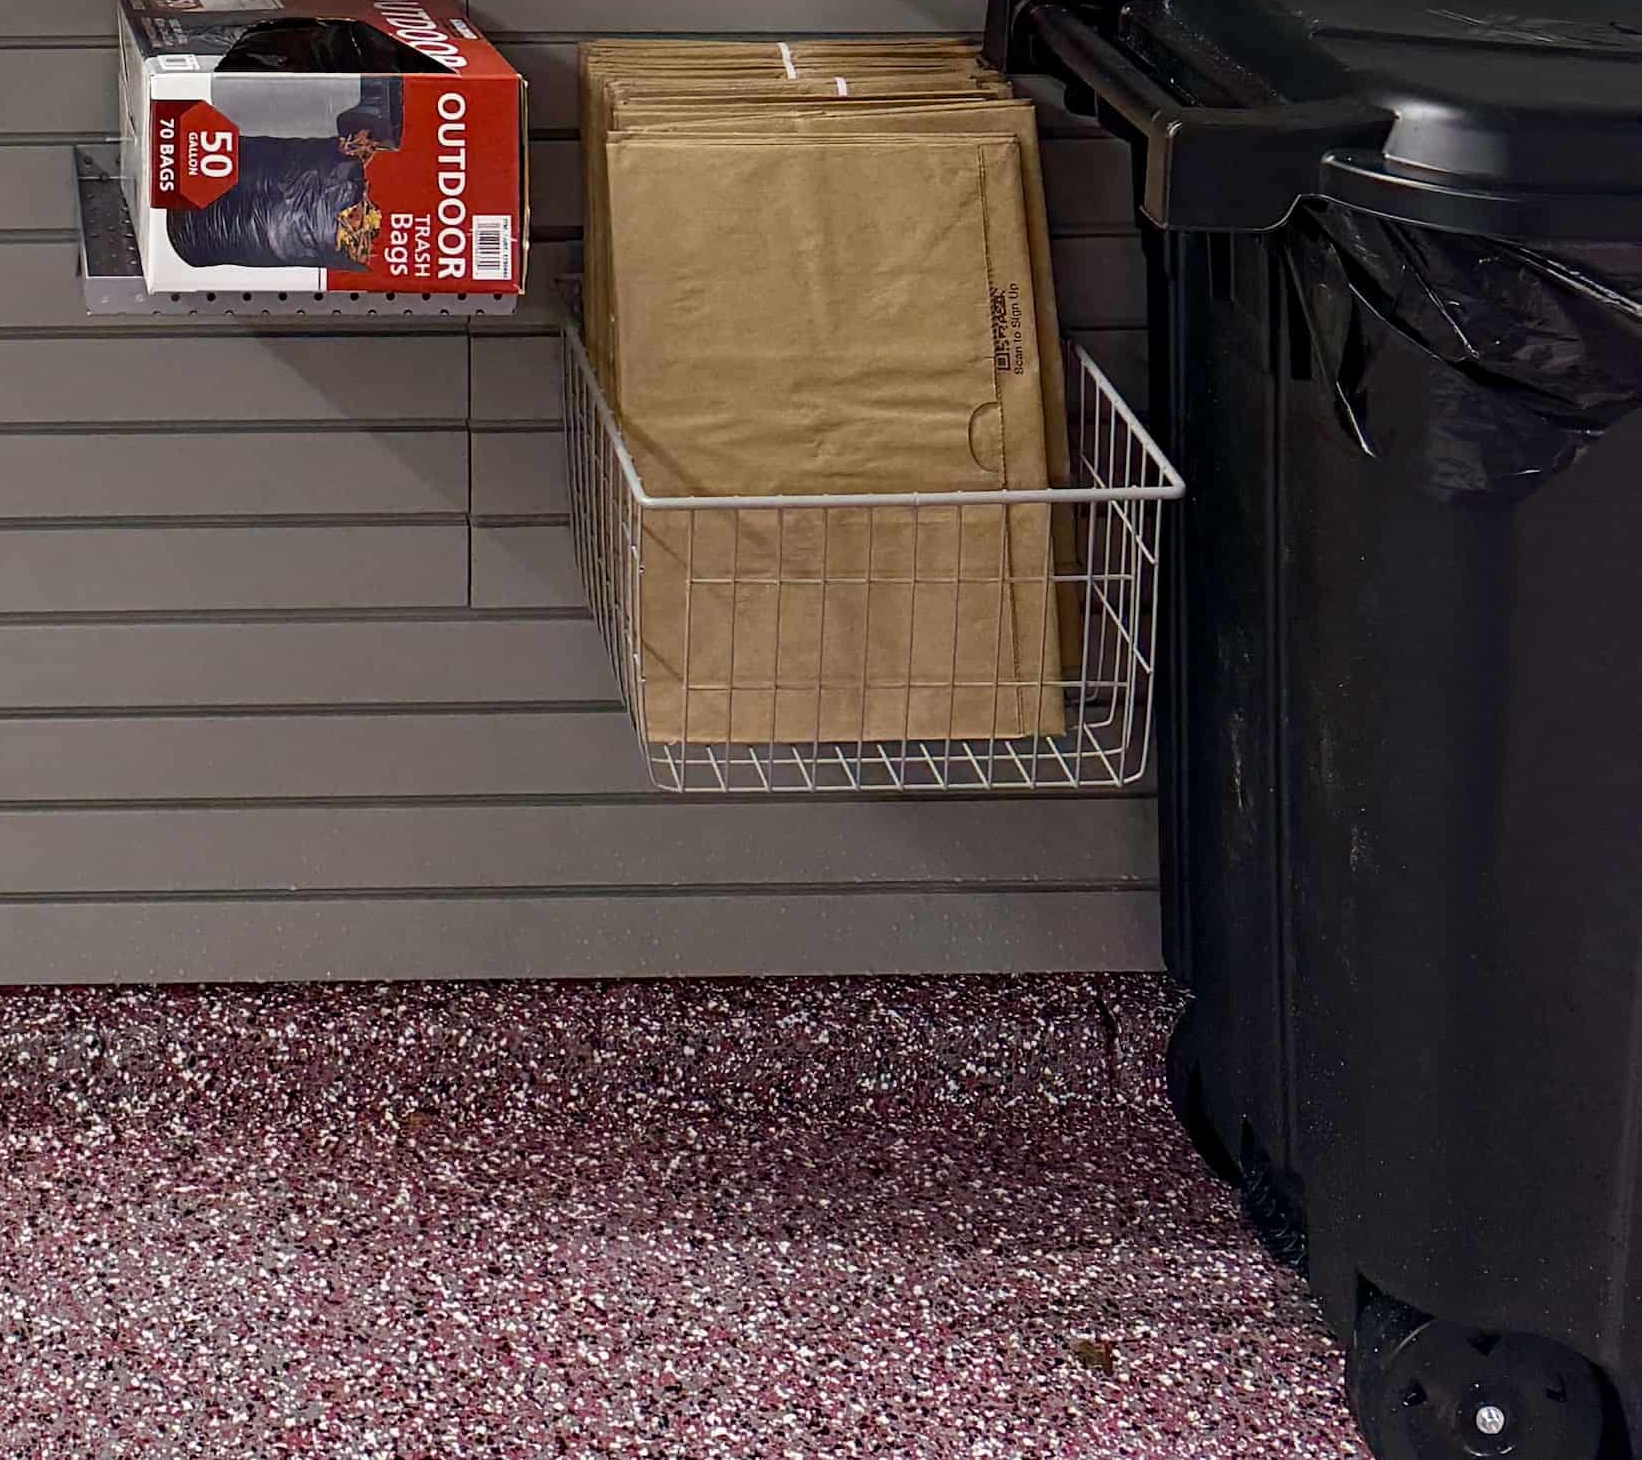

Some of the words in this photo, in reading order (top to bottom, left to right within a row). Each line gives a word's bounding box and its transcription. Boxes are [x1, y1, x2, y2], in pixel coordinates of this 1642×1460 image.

[159, 118, 174, 139] 70
[159, 144, 174, 192] BAGS
[188, 132, 198, 176] GALLON
[200, 131, 233, 177] 50
[438, 92, 466, 279] OUTDOOR
[384, 213, 413, 275] Bags
[414, 214, 431, 276] TRASH
[1008, 283, 1019, 299] Up
[1011, 303, 1022, 329] Sign
[1014, 331, 1022, 342] to
[1014, 346, 1024, 375] Scan
